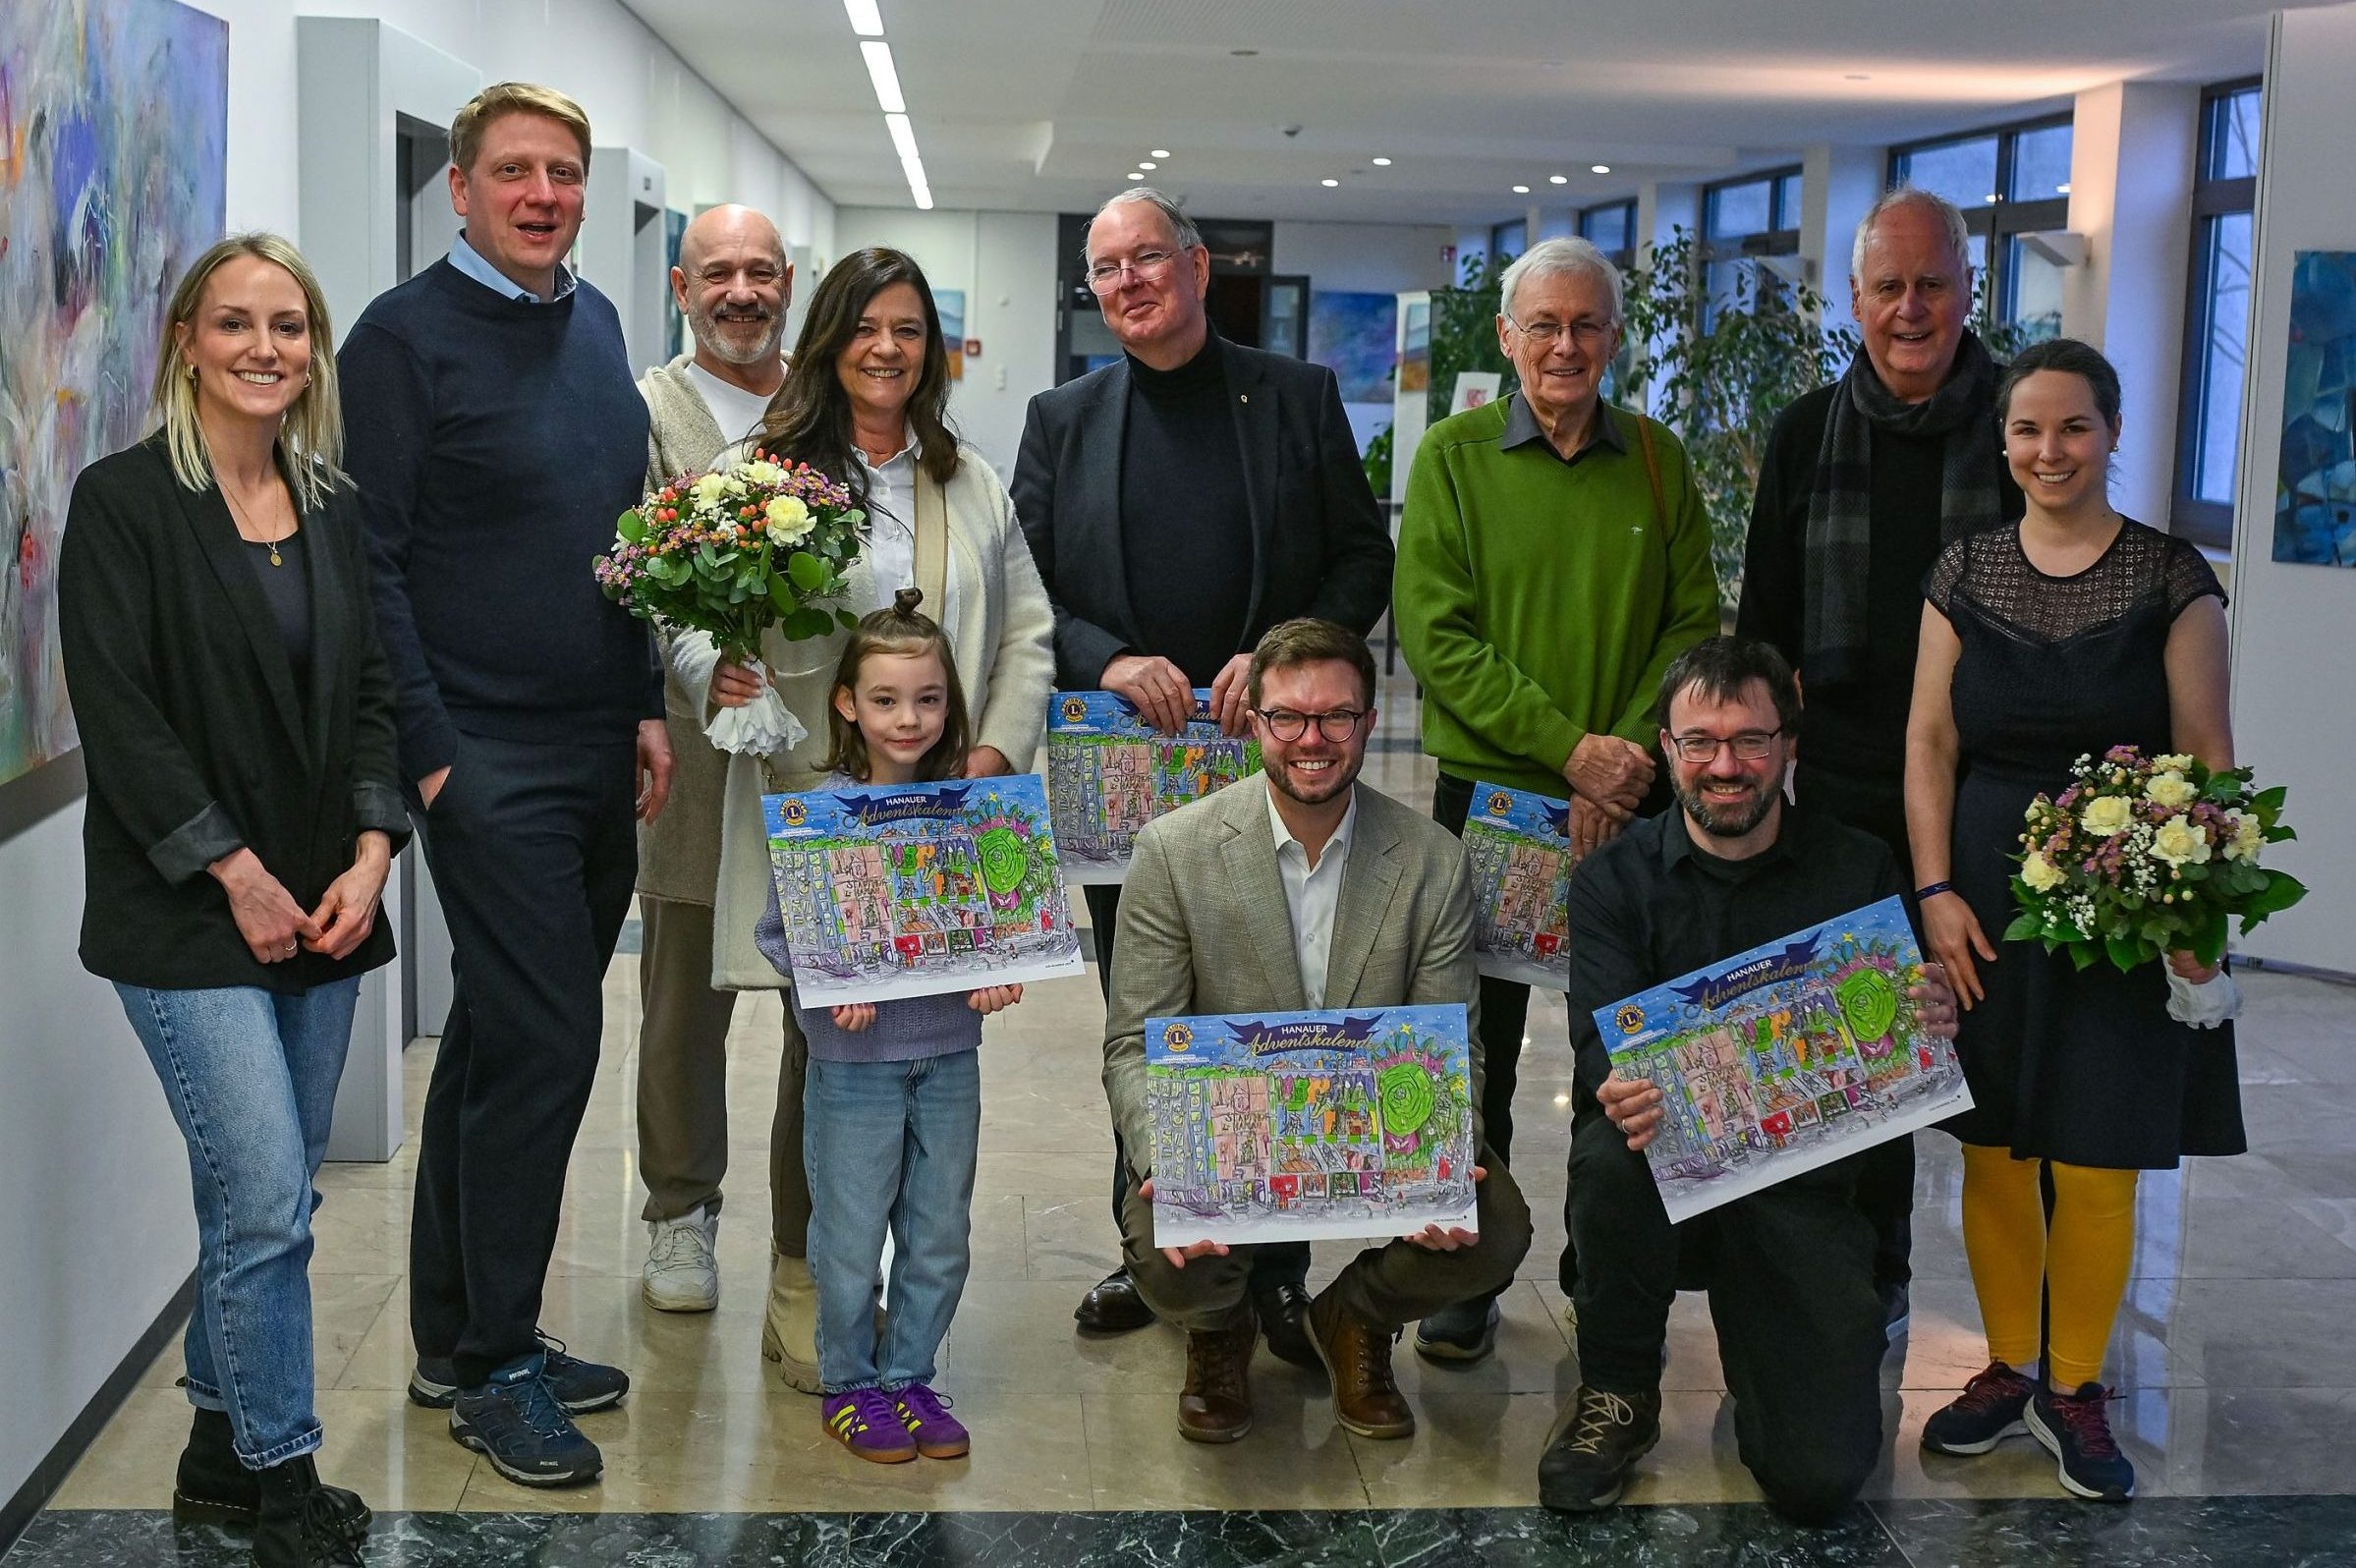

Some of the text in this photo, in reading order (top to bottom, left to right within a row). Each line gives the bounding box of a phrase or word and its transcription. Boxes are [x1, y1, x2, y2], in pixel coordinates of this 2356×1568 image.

[1071, 705, 1079, 714] L
[886, 796, 927, 807] HANAUER
[790, 807, 799, 817] L
[843, 799, 977, 829] Adventskalend
[1727, 959, 1773, 982] HANAUER
[1684, 958, 1833, 1019] Adventskalen
[1626, 1014, 1637, 1025] L
[1281, 1025, 1328, 1035] HANAUER
[1174, 1033, 1183, 1043] L
